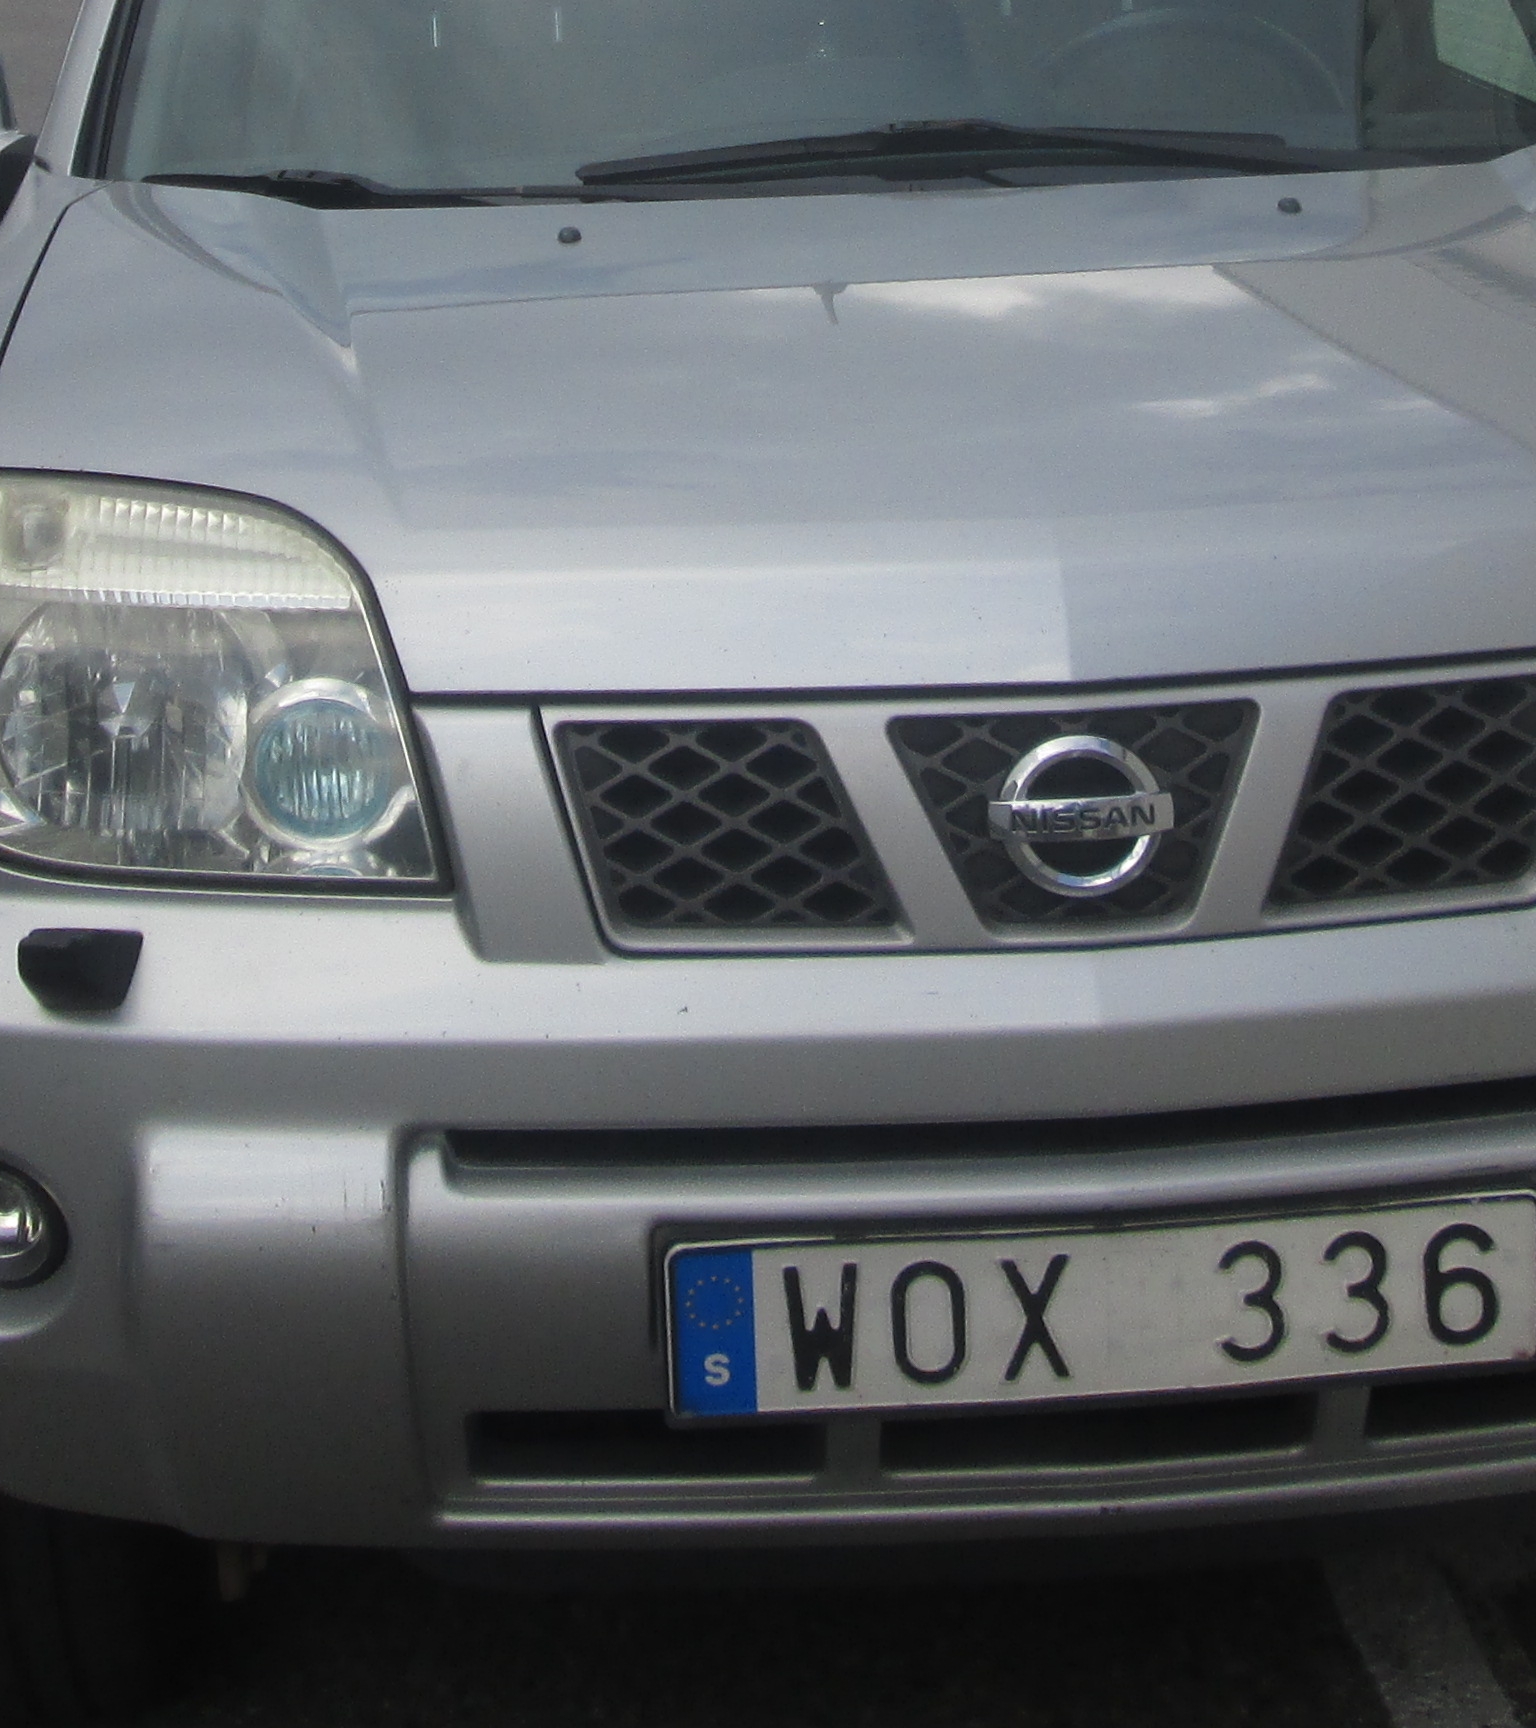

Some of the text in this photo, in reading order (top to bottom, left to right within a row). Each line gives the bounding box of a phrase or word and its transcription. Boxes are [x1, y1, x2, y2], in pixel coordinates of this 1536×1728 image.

[1010, 803, 1156, 835] NISSAN
[782, 1223, 1501, 1392] WOX 336
[704, 1353, 731, 1386] S
